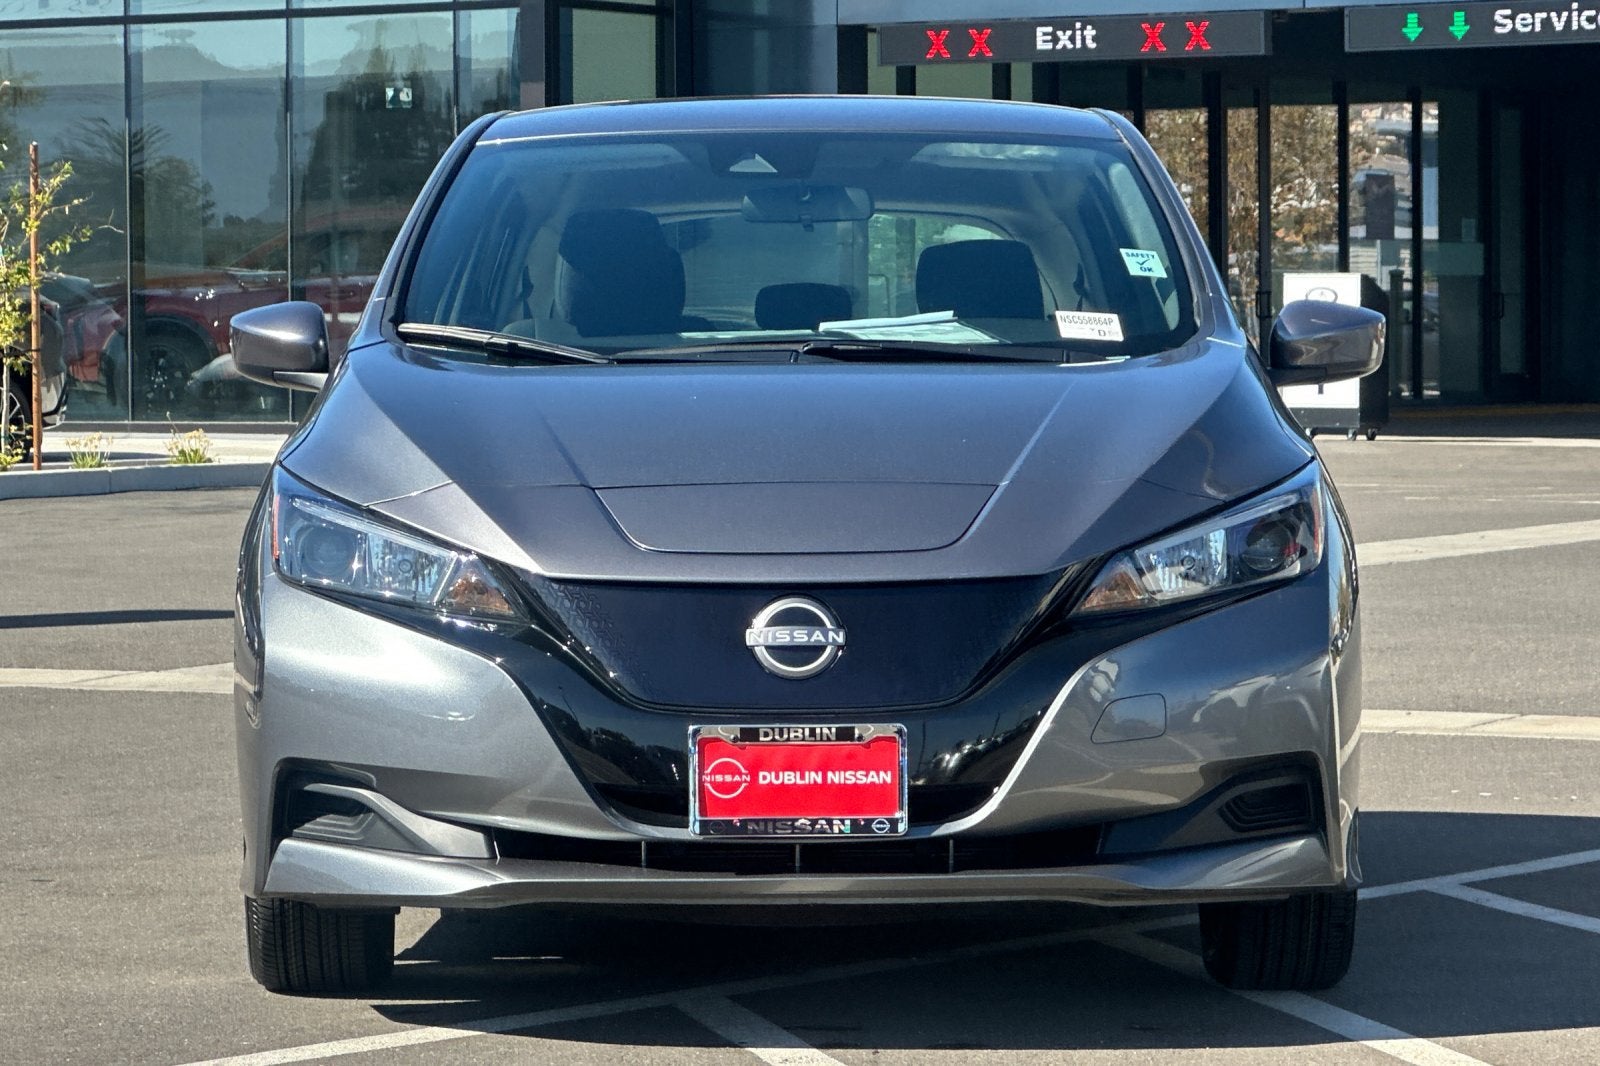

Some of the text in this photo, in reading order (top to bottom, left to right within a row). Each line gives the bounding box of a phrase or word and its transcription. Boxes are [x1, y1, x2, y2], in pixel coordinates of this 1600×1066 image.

[1493, 2, 1600, 34] Servic
[1036, 21, 1098, 50] Exit
[1125, 251, 1155, 259] SAFETY
[748, 630, 845, 644] NISSAN
[759, 727, 836, 742] DUBLIN
[702, 774, 751, 783] NISSAN
[758, 771, 892, 784] DUBLIN NISSAN
[747, 818, 851, 834] NISSAN
